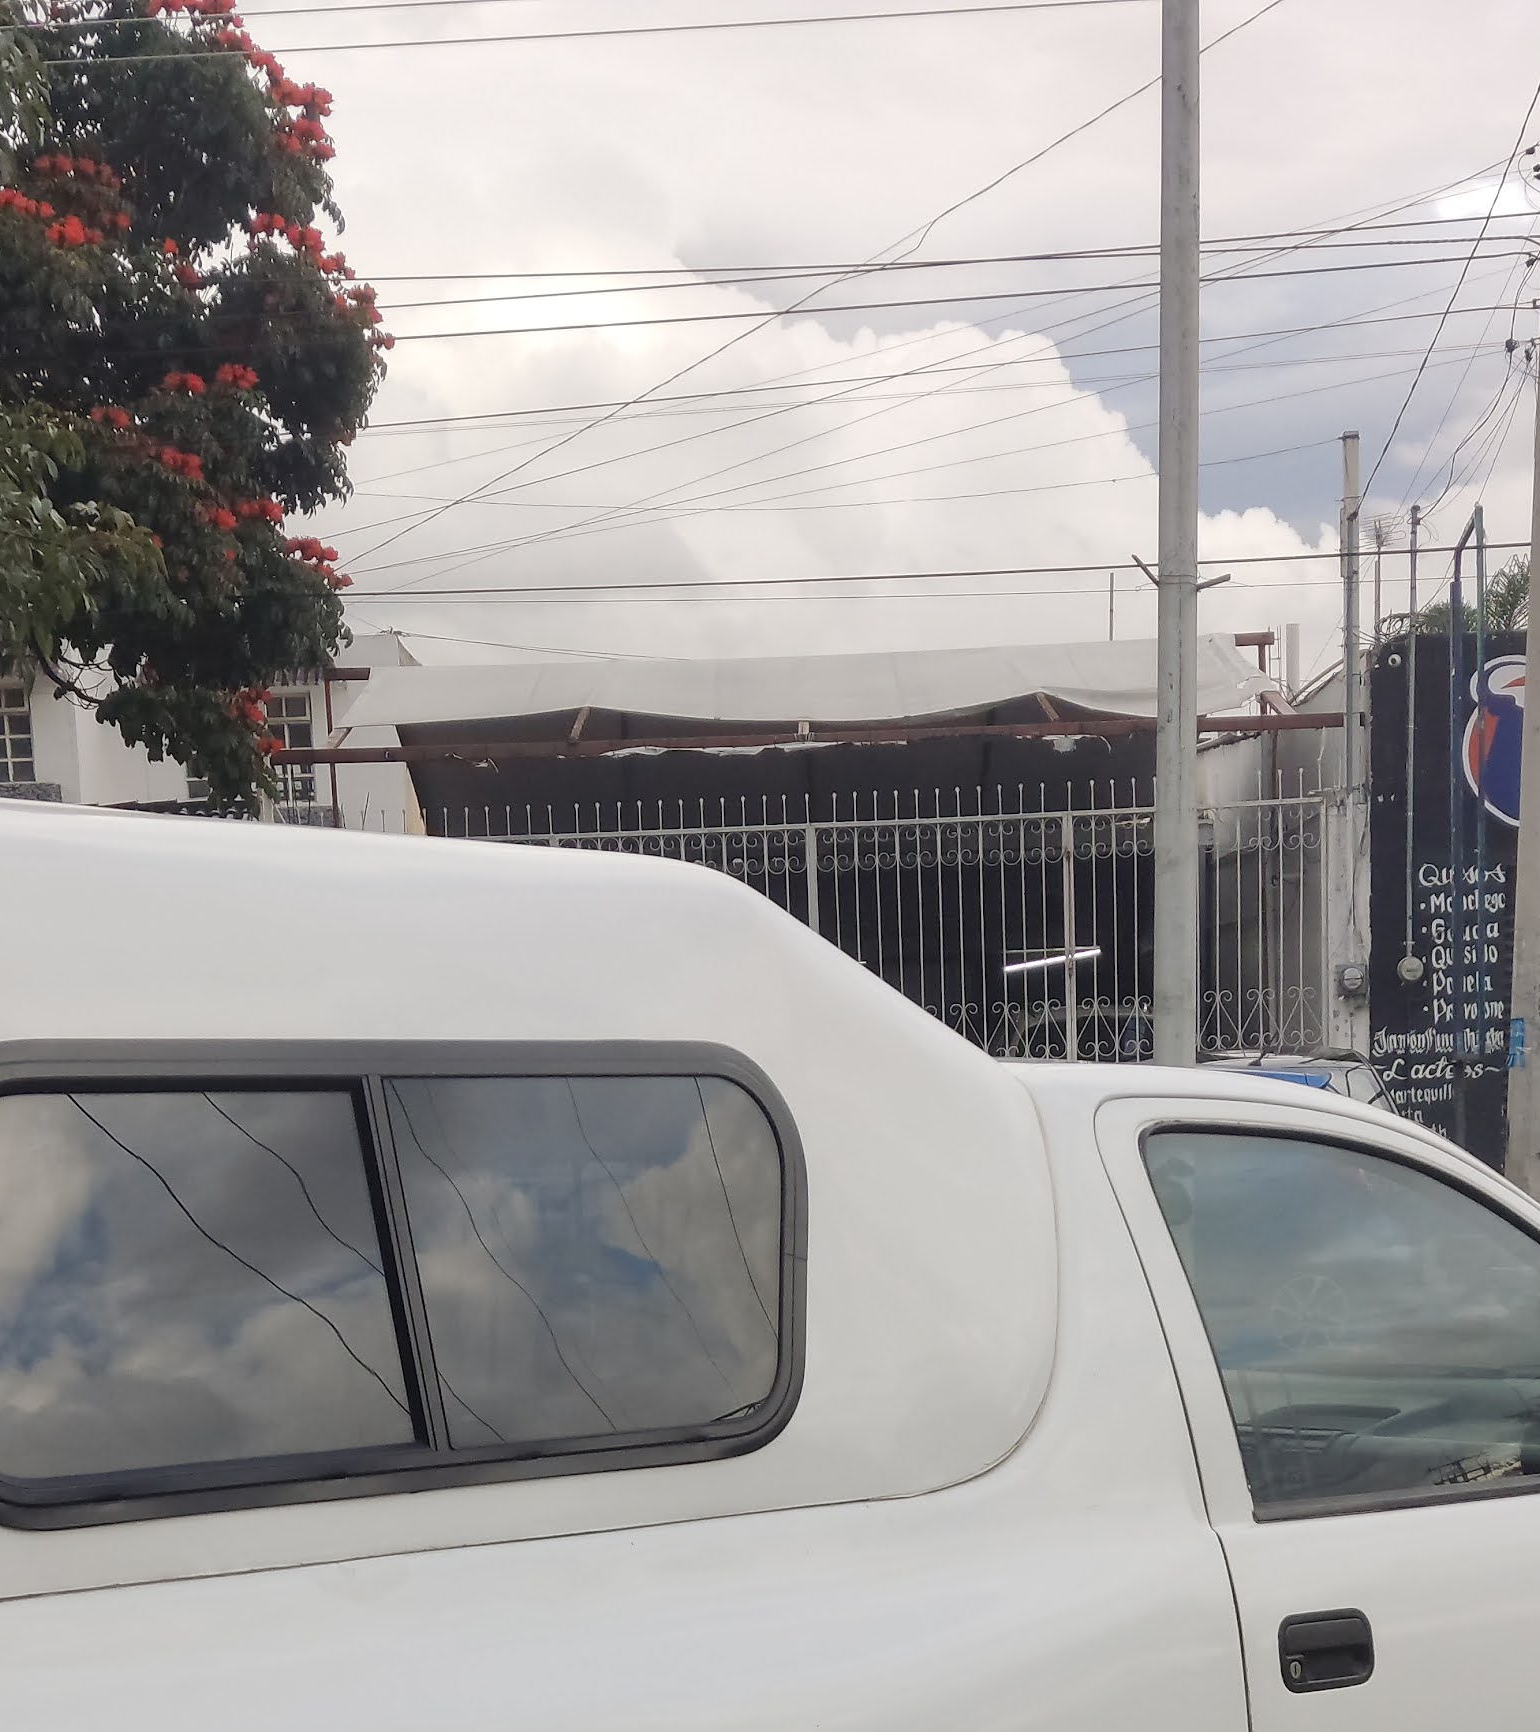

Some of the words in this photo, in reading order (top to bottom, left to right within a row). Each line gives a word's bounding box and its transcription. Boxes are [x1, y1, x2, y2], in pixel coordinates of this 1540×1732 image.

[1419, 863, 1506, 887] Qusos
[1431, 943, 1498, 970] Qusilo
[1433, 998, 1505, 1025] Prvoone
